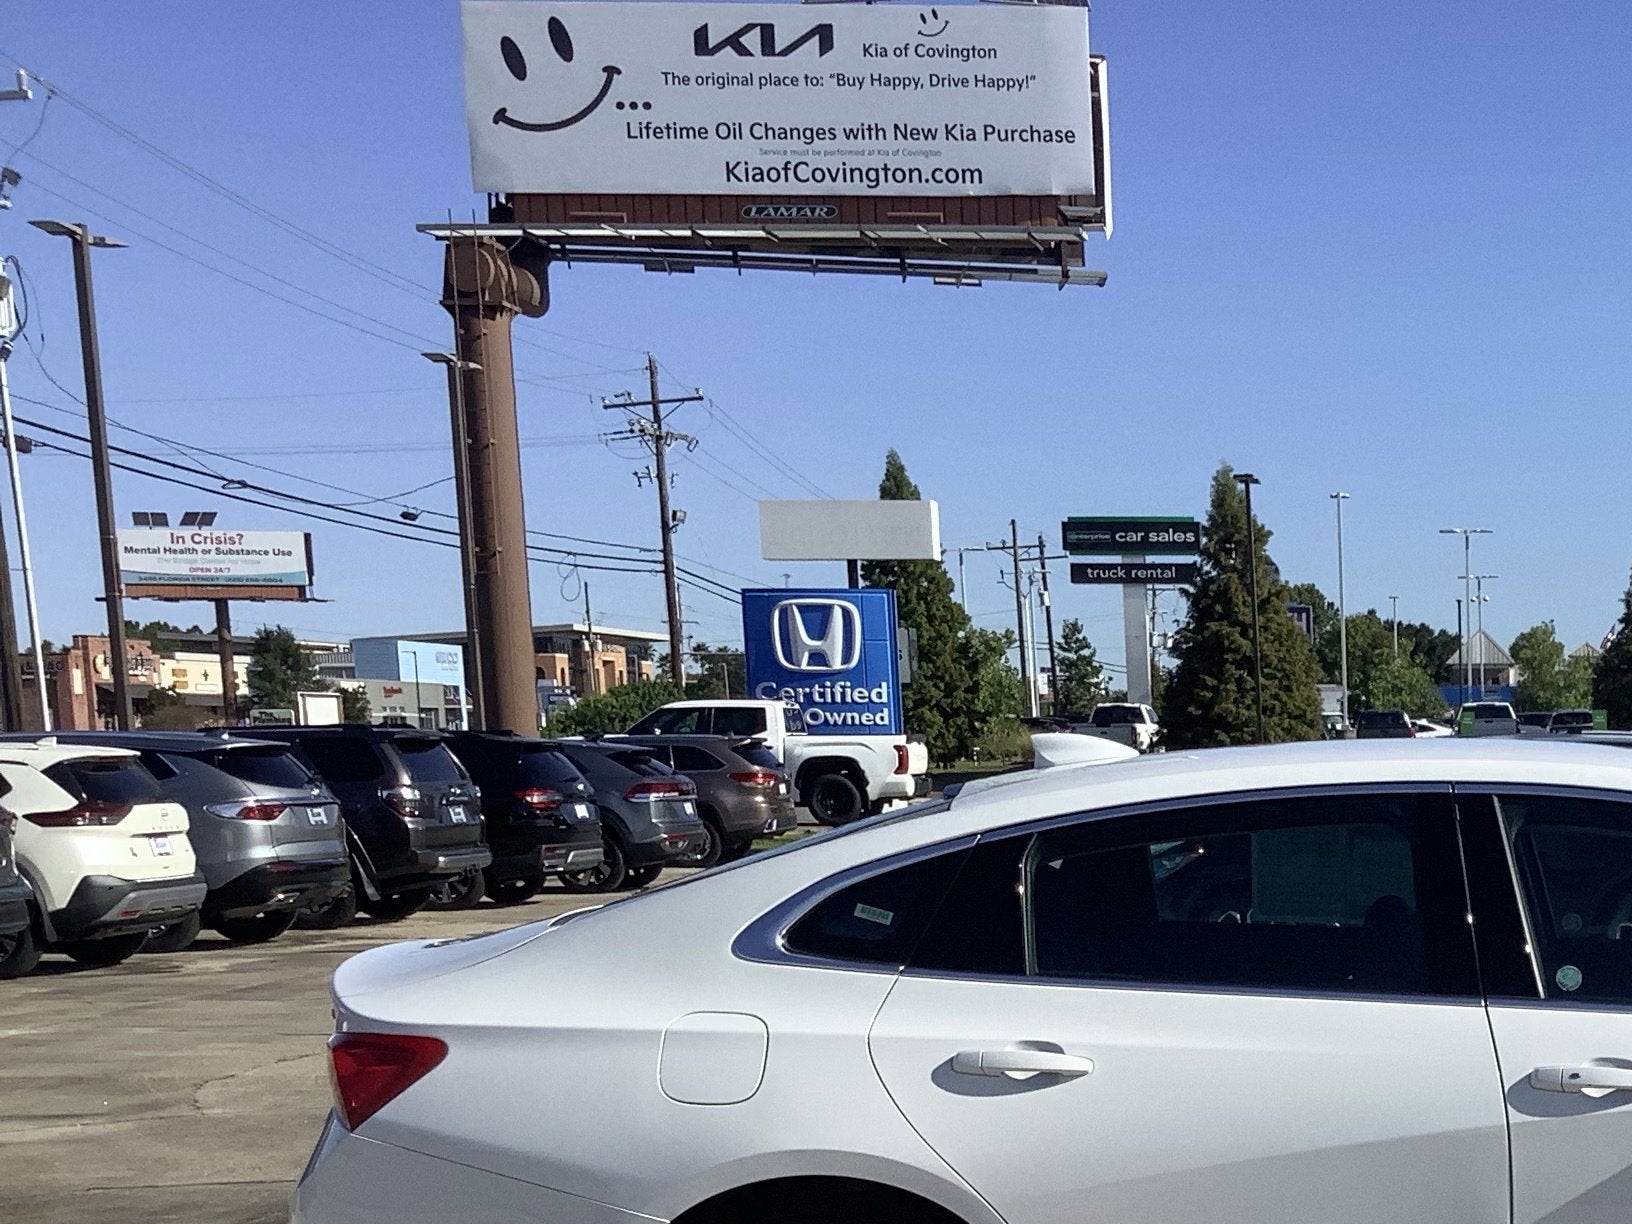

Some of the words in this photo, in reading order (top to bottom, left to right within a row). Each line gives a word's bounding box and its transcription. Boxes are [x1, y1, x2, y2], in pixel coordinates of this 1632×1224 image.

[862, 43, 888, 58] Kia
[893, 43, 910, 58] of
[914, 43, 998, 62] Covington
[661, 71, 690, 86] The
[695, 72, 754, 90] original
[758, 73, 799, 90] place
[803, 74, 824, 87] to:
[870, 73, 924, 91] Happy,
[929, 73, 969, 88] Drive
[626, 121, 709, 140] Lifetime
[715, 122, 743, 140] Oil
[750, 122, 837, 144] Changes
[843, 123, 887, 141] with
[893, 123, 938, 141] New
[945, 124, 976, 142] Kia
[984, 124, 1076, 143] Purchase
[759, 148, 788, 157] Service
[790, 149, 809, 157] must
[811, 149, 822, 157] be
[823, 149, 865, 158] performed
[867, 149, 876, 157] at
[877, 149, 890, 157] Kia
[891, 149, 901, 157] of
[902, 149, 942, 159] Covington
[725, 161, 983, 188] KiaofCovington.com
[750, 206, 828, 217] LAMAR
[170, 532, 185, 545] In
[191, 532, 244, 546] Crisis?
[1115, 531, 1145, 542] car
[1149, 528, 1195, 542] sales
[124, 546, 160, 555] Mental
[164, 546, 198, 556] Health
[201, 547, 212, 556] or
[215, 547, 270, 556] Substance
[272, 548, 293, 557] Use
[188, 566, 212, 574] OPEN
[1087, 566, 1126, 579] truck
[1131, 566, 1176, 579] rental
[755, 681, 888, 703] Certified
[805, 708, 889, 726] Owned
